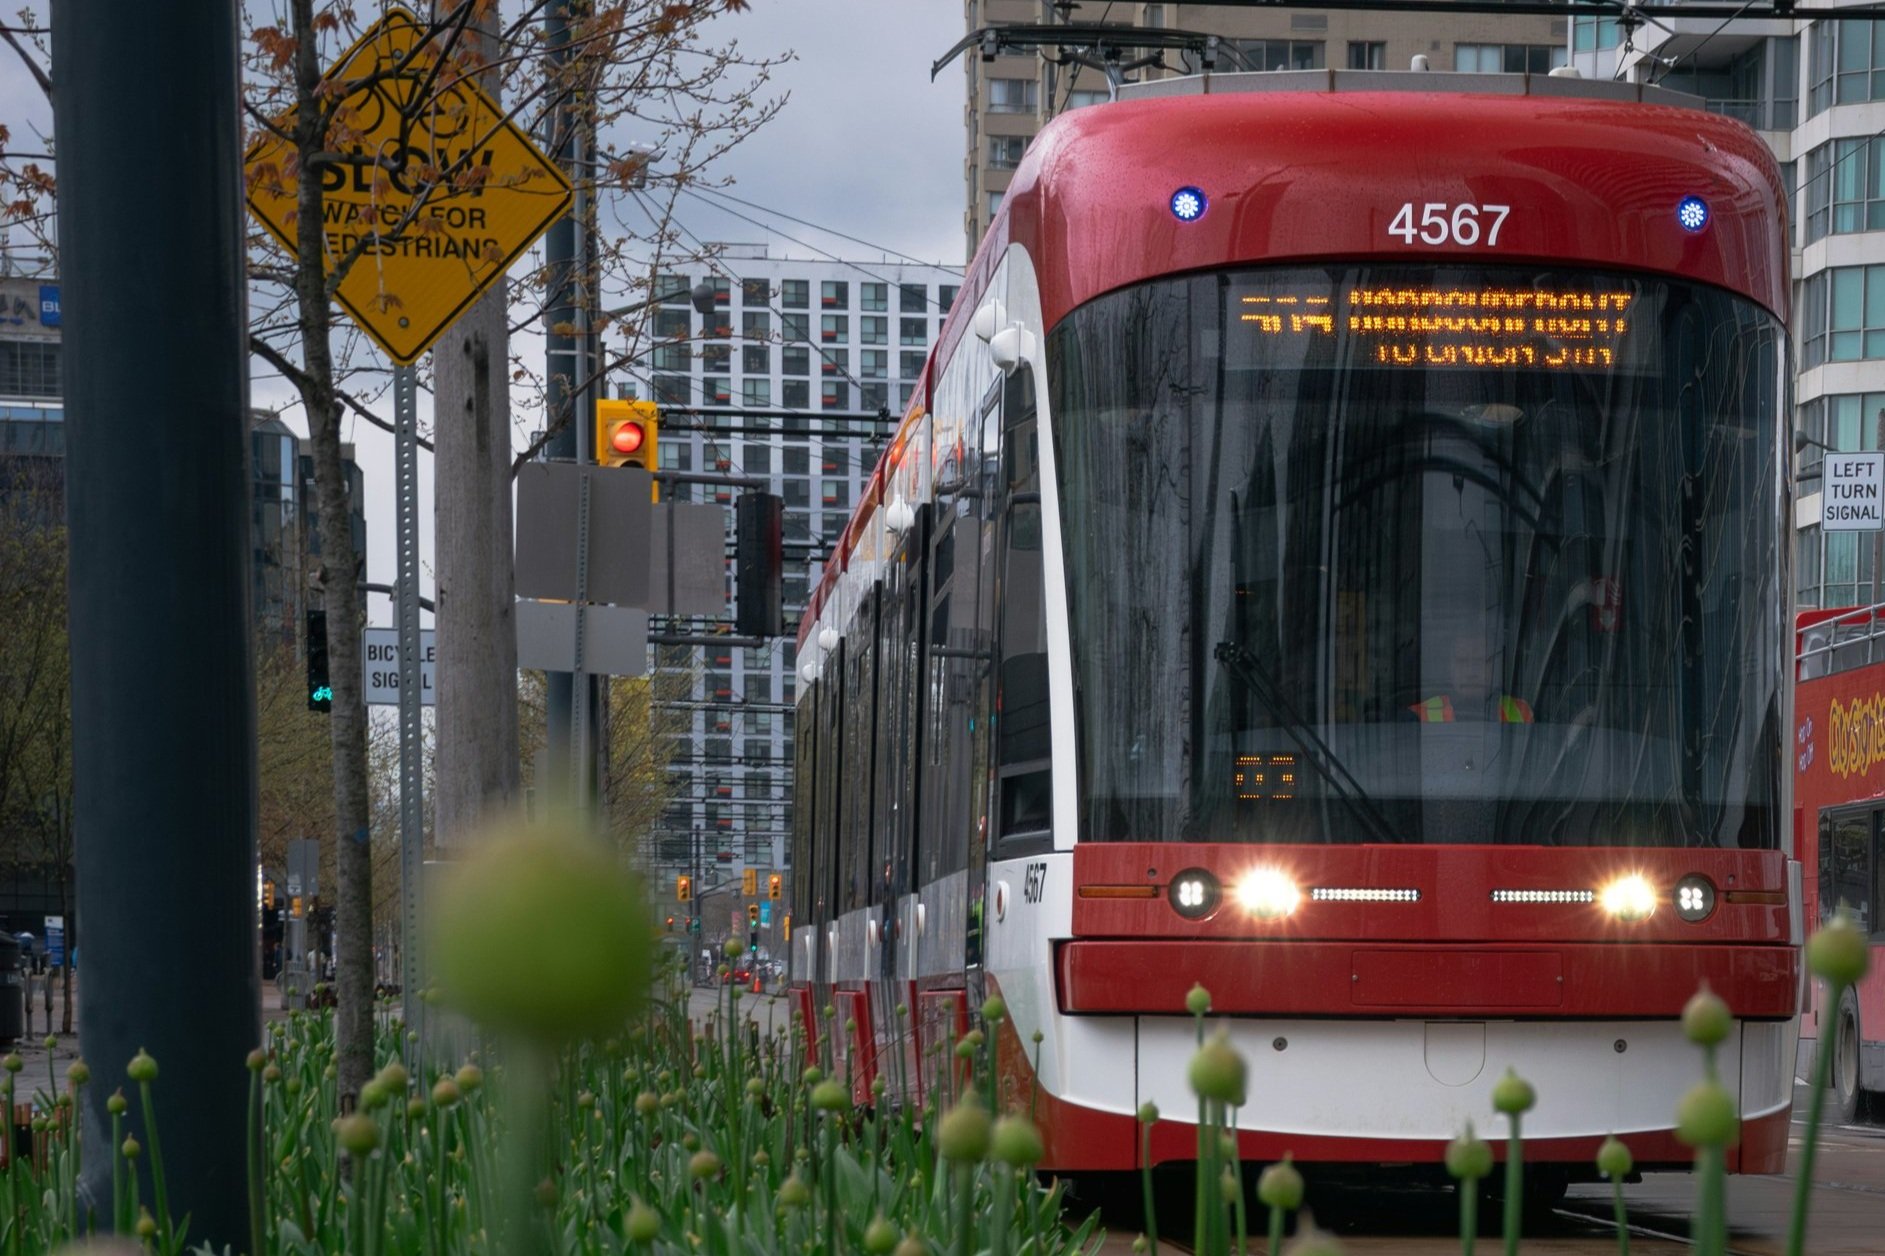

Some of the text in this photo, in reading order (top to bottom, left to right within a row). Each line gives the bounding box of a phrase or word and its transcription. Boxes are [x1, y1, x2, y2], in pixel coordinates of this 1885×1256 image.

[431, 206, 486, 229] FOR
[1388, 203, 1510, 246] 4567
[324, 232, 499, 260] EDESTRIAN
[1833, 462, 1875, 477] LEFT
[1831, 484, 1877, 499] TURN
[1826, 505, 1880, 520] SIGNAL
[367, 645, 435, 662] BICE
[372, 671, 432, 689] SIGL
[1024, 863, 1047, 904] 4567
